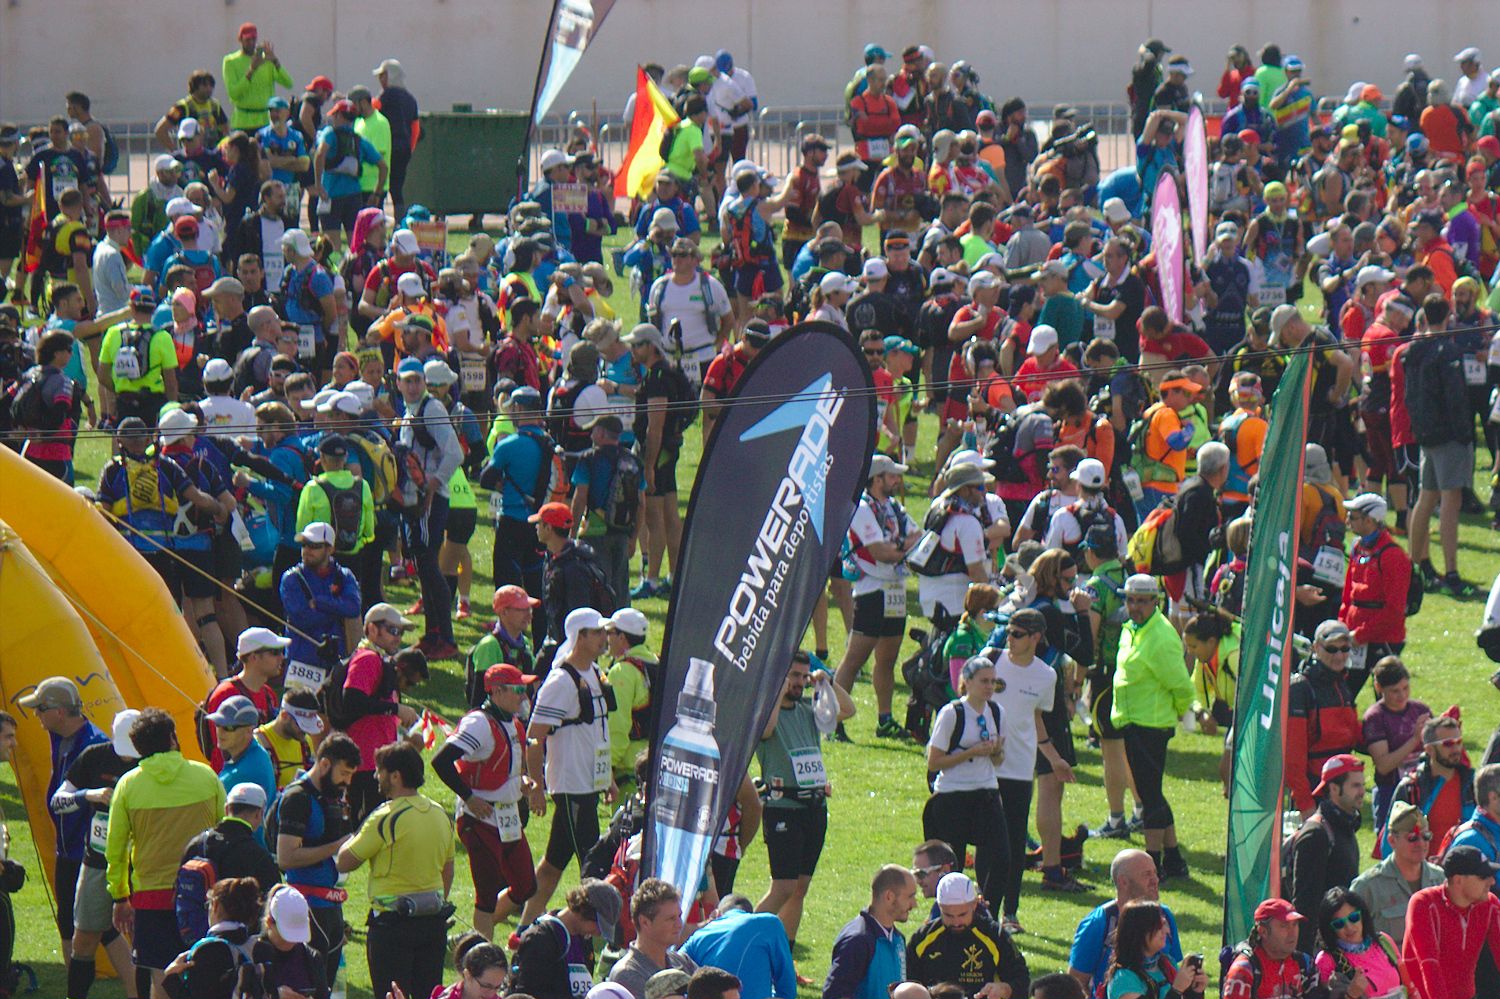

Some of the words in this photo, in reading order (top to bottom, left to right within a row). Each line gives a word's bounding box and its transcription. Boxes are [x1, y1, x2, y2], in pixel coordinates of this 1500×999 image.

[714, 379, 845, 662] POWERADE
[733, 607, 770, 673] bebida
[761, 559, 790, 610] para
[782, 451, 835, 558] deportistas
[1261, 531, 1291, 730] Unicaja
[660, 756, 719, 785] POWERADE
[797, 760, 824, 775] 2658
